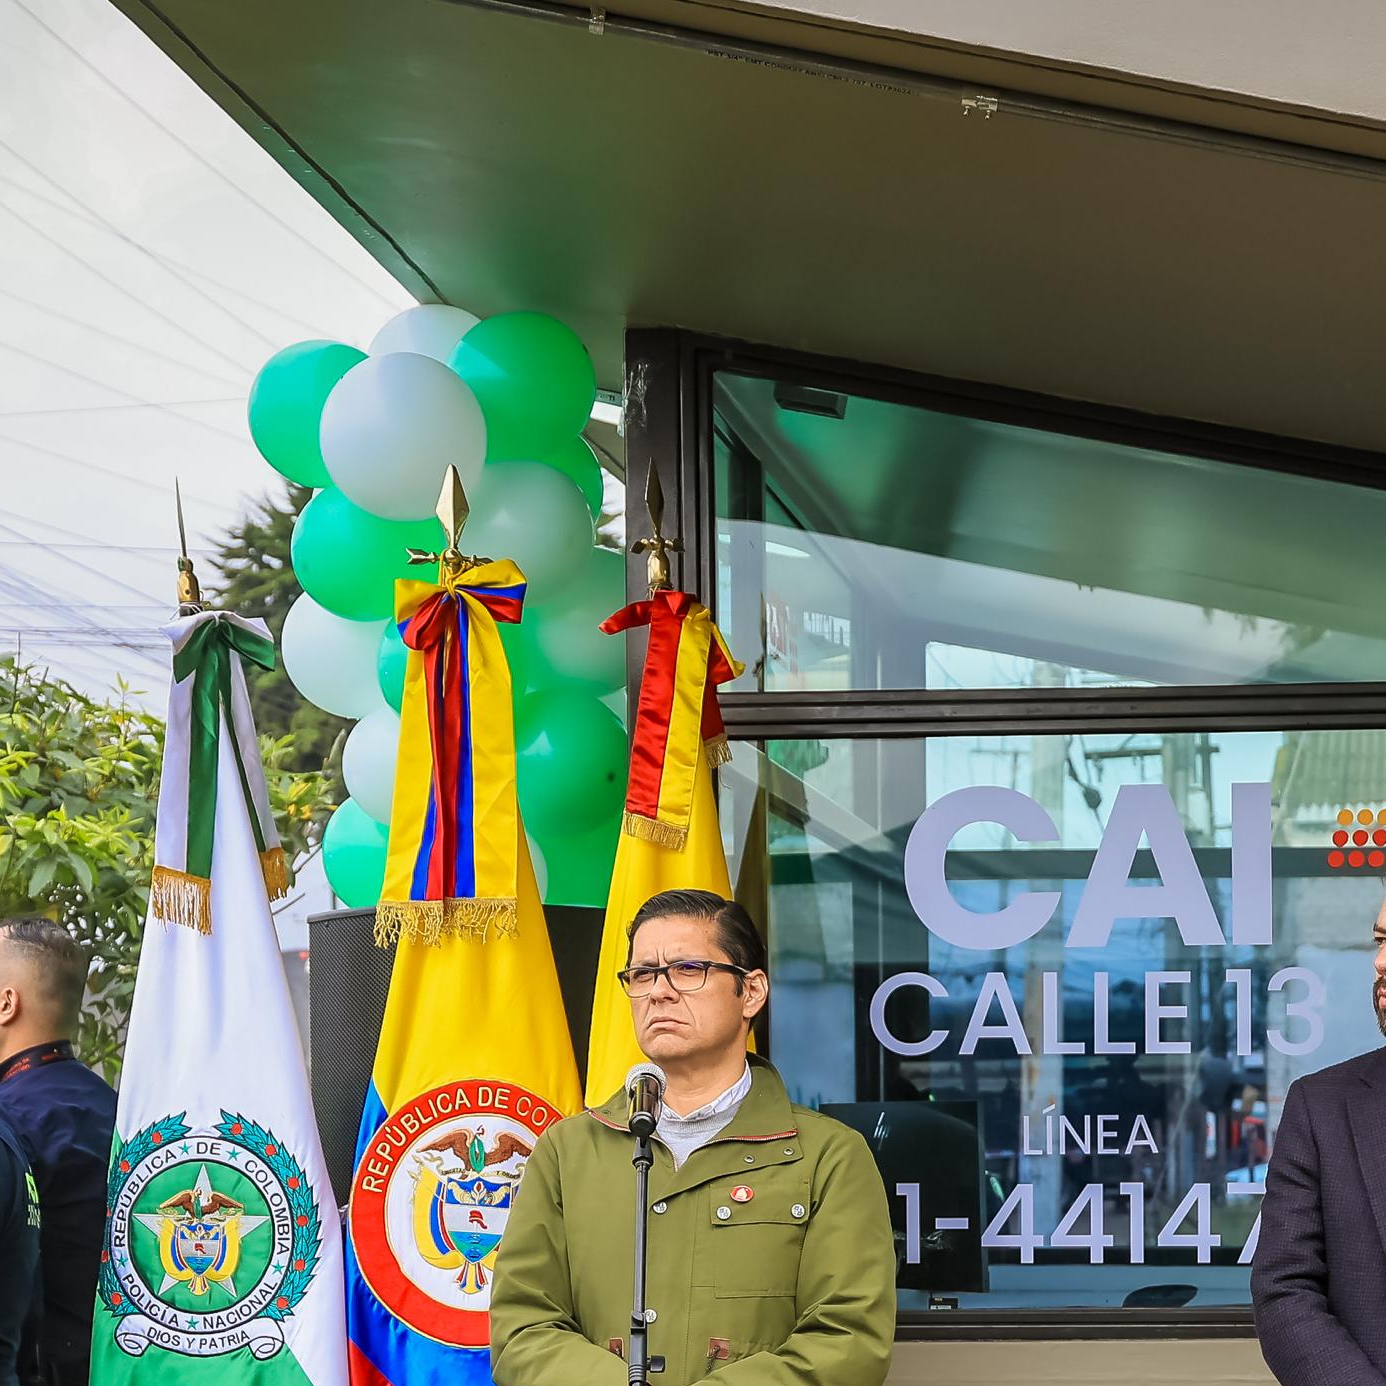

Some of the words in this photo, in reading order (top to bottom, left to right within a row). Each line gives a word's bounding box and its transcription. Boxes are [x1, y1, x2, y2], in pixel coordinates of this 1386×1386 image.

[904, 781, 1273, 950] CAI
[869, 970, 1193, 1057] CALLE
[1225, 966, 1326, 1057] 13
[362, 1087, 472, 1194] REPÚBLICA
[477, 1086, 511, 1110] DE
[1022, 1103, 1159, 1156] LÍNEA
[113, 1147, 178, 1248] REPÚBLICA
[195, 1141, 222, 1156] DE
[244, 1158, 291, 1256] COLOMBIA
[895, 1181, 1268, 1265] 1-44147
[122, 1274, 180, 1328] POLICÍA
[202, 1281, 281, 1331] NACIONAL
[146, 1325, 181, 1347] DIOS
[186, 1337, 197, 1350] Y
[198, 1329, 251, 1350] PATRIA
